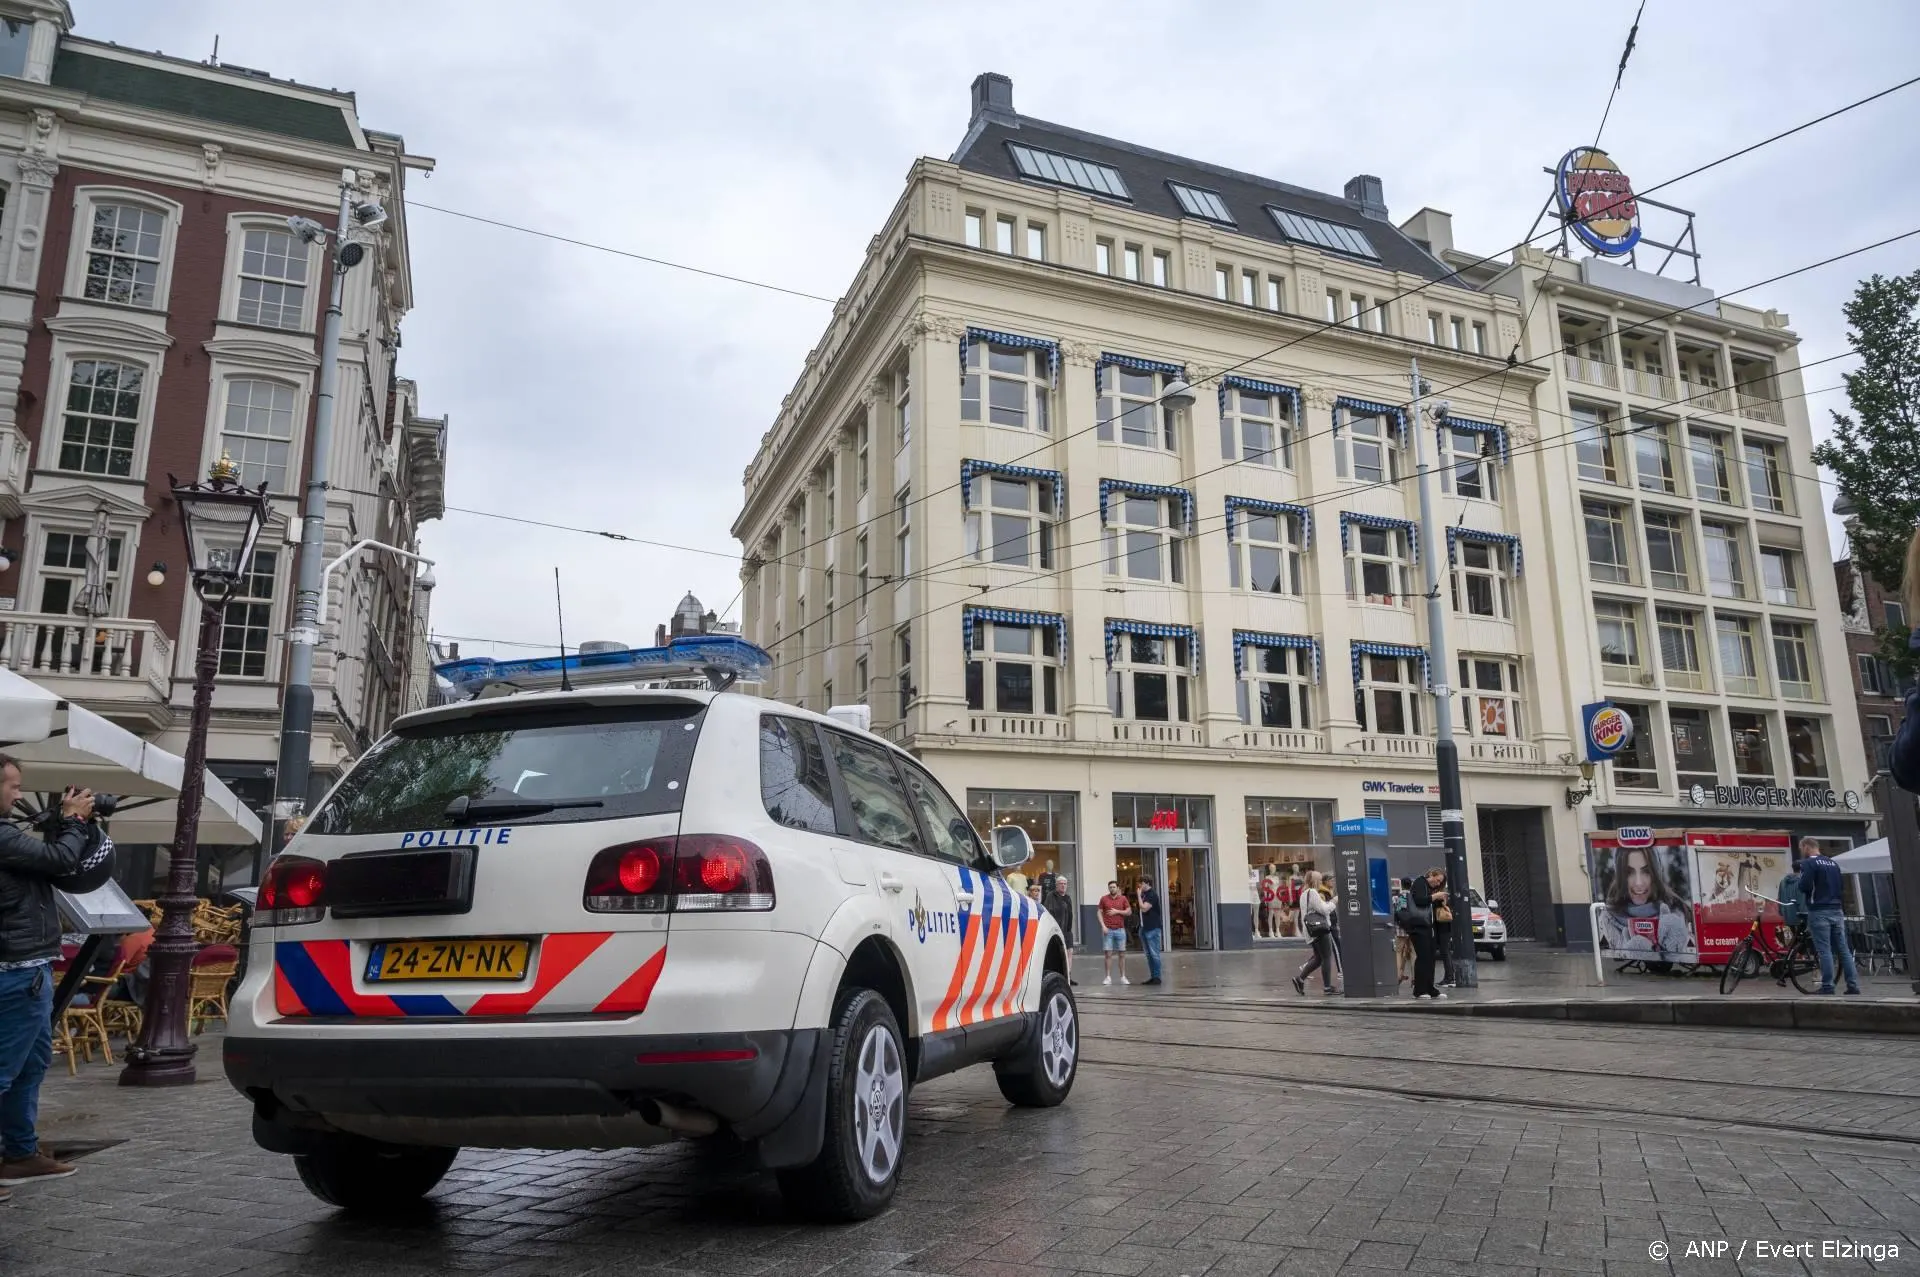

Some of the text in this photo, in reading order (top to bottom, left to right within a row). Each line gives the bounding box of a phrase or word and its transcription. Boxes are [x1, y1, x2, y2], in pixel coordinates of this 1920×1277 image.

[1568, 172, 1630, 192] BURGER
[1575, 192, 1636, 219] KING
[1594, 714, 1621, 732] BURGER
[1596, 722, 1622, 744] KING
[1362, 781, 1386, 792] GWK
[1387, 782, 1424, 793] Travelex
[1715, 785, 1788, 807] BURGER
[1791, 787, 1837, 808] KING
[1336, 824, 1360, 832] Tickets
[401, 828, 512, 849] POLITIE
[1815, 859, 1836, 867] ITALIA
[387, 944, 516, 974] 24-ZN-NK
